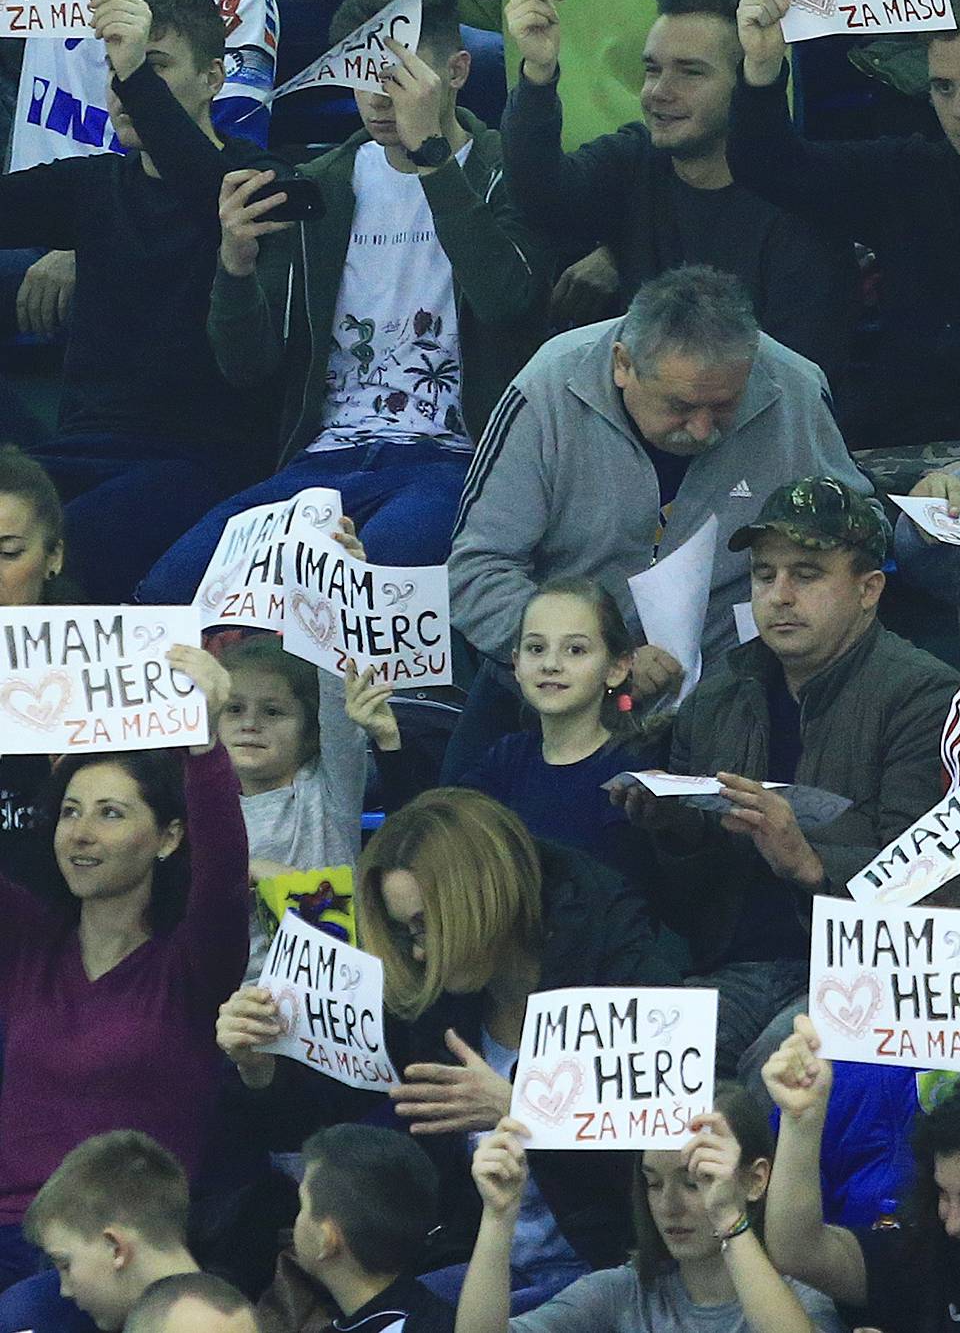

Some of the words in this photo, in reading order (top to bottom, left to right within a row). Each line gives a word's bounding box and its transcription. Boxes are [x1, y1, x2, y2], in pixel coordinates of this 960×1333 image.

[7, 6, 43, 30] ZA
[839, 3, 880, 28] ZA
[300, 65, 330, 82] ZA
[296, 542, 374, 610] IMAM
[220, 593, 258, 619] ZA
[4, 614, 125, 669] IMAM
[340, 610, 441, 657] HERC
[81, 659, 195, 713] HERC
[370, 652, 446, 685] MAŠU
[65, 717, 111, 746] ZA
[121, 705, 201, 740] MAŠU
[270, 929, 337, 989] IMAM
[826, 918, 935, 967] IMAM
[305, 993, 380, 1053] HERC
[533, 998, 637, 1058] IMAM
[872, 1028, 918, 1058] ZA
[300, 1038, 331, 1067] ZA
[594, 1047, 703, 1103] HERC
[574, 1112, 616, 1141] ZA
